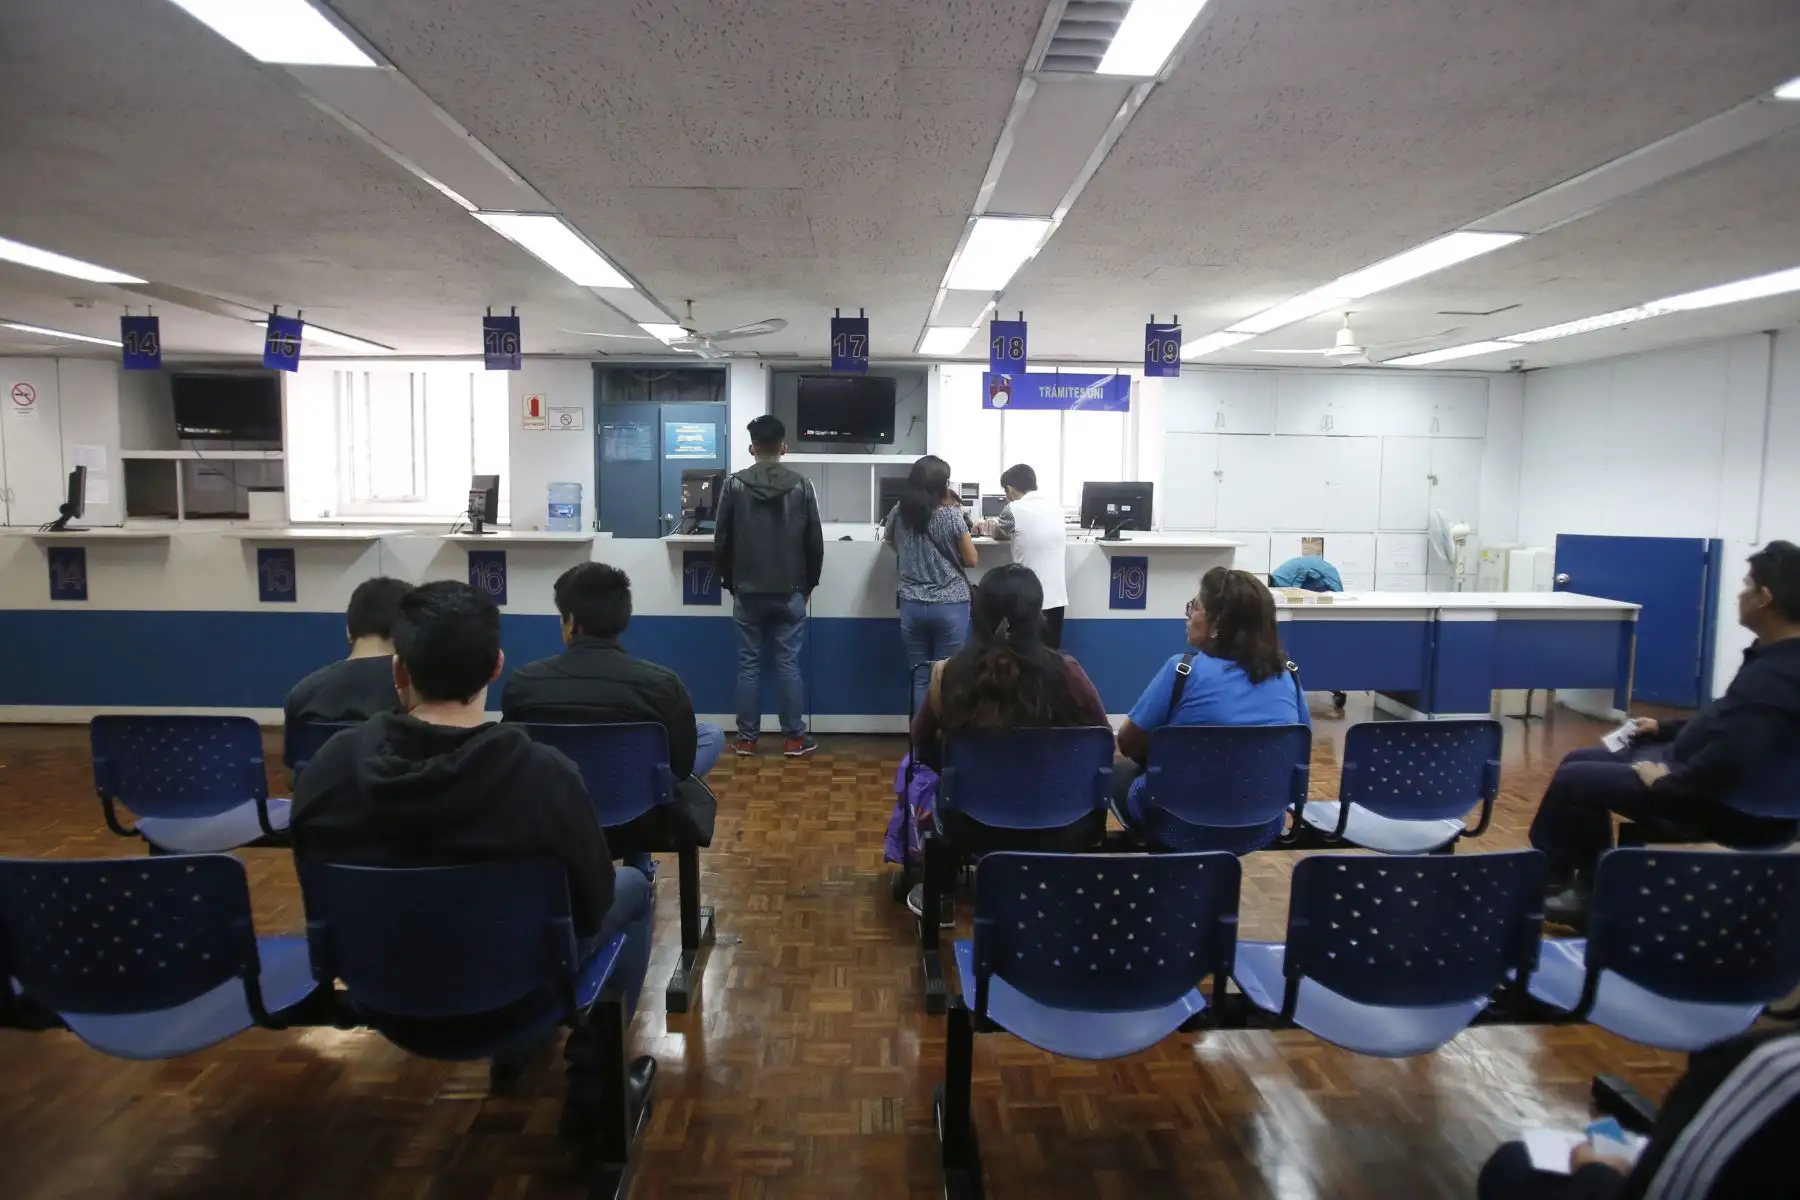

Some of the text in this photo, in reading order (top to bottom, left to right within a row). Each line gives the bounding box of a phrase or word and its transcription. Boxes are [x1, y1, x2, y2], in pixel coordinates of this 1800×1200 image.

[123, 331, 158, 356] 14
[268, 330, 298, 358] 15
[486, 332, 518, 357] 16
[833, 333, 867, 358] 17
[992, 336, 1024, 360] 18
[1147, 339, 1179, 364] 19
[1038, 384, 1086, 400] TRÁMITES
[52, 560, 84, 590] 14
[260, 558, 293, 592] 15
[471, 561, 504, 595] 16
[685, 561, 717, 595] 17
[1112, 566, 1145, 600] 19
